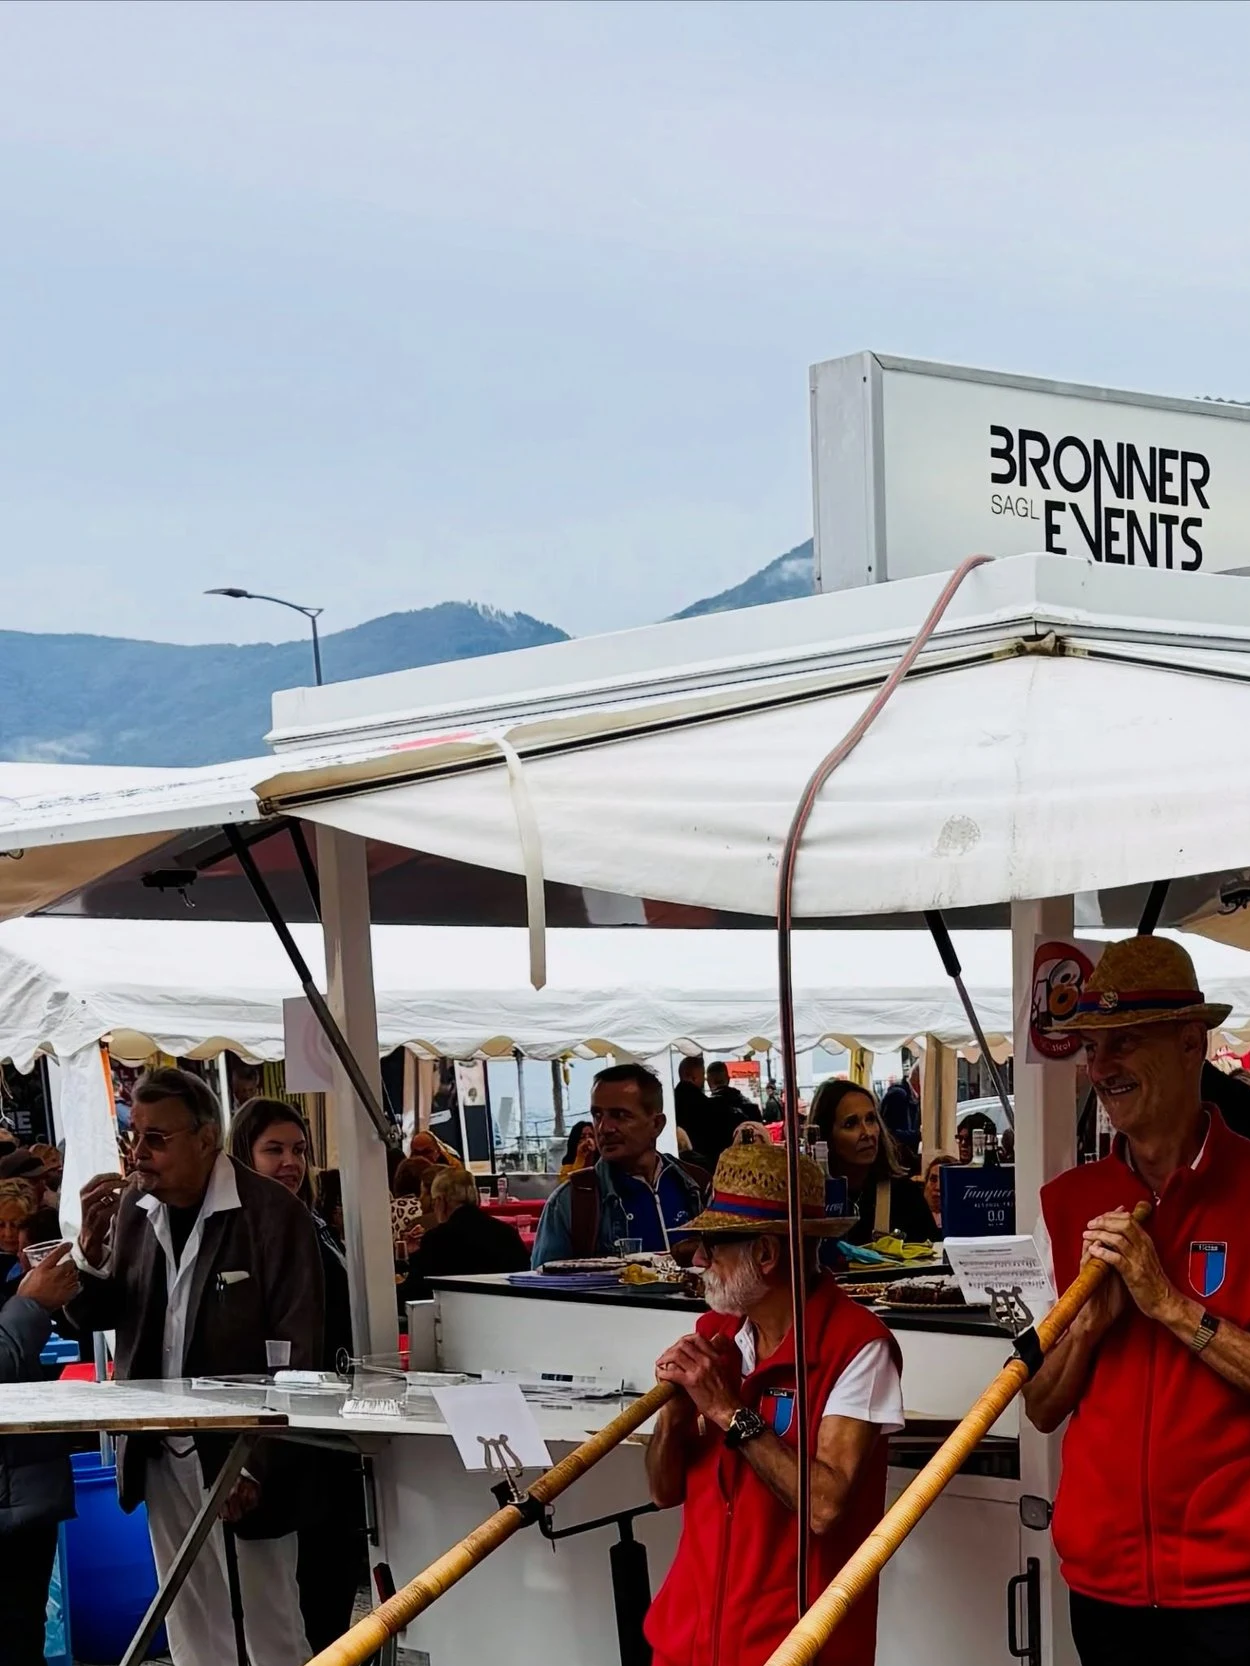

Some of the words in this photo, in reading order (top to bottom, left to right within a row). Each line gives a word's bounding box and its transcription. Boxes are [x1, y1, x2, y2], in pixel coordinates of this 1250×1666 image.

[989, 423, 1211, 510] BRONNER
[990, 493, 1041, 521] SAGL
[1044, 499, 1203, 572] EVENTS
